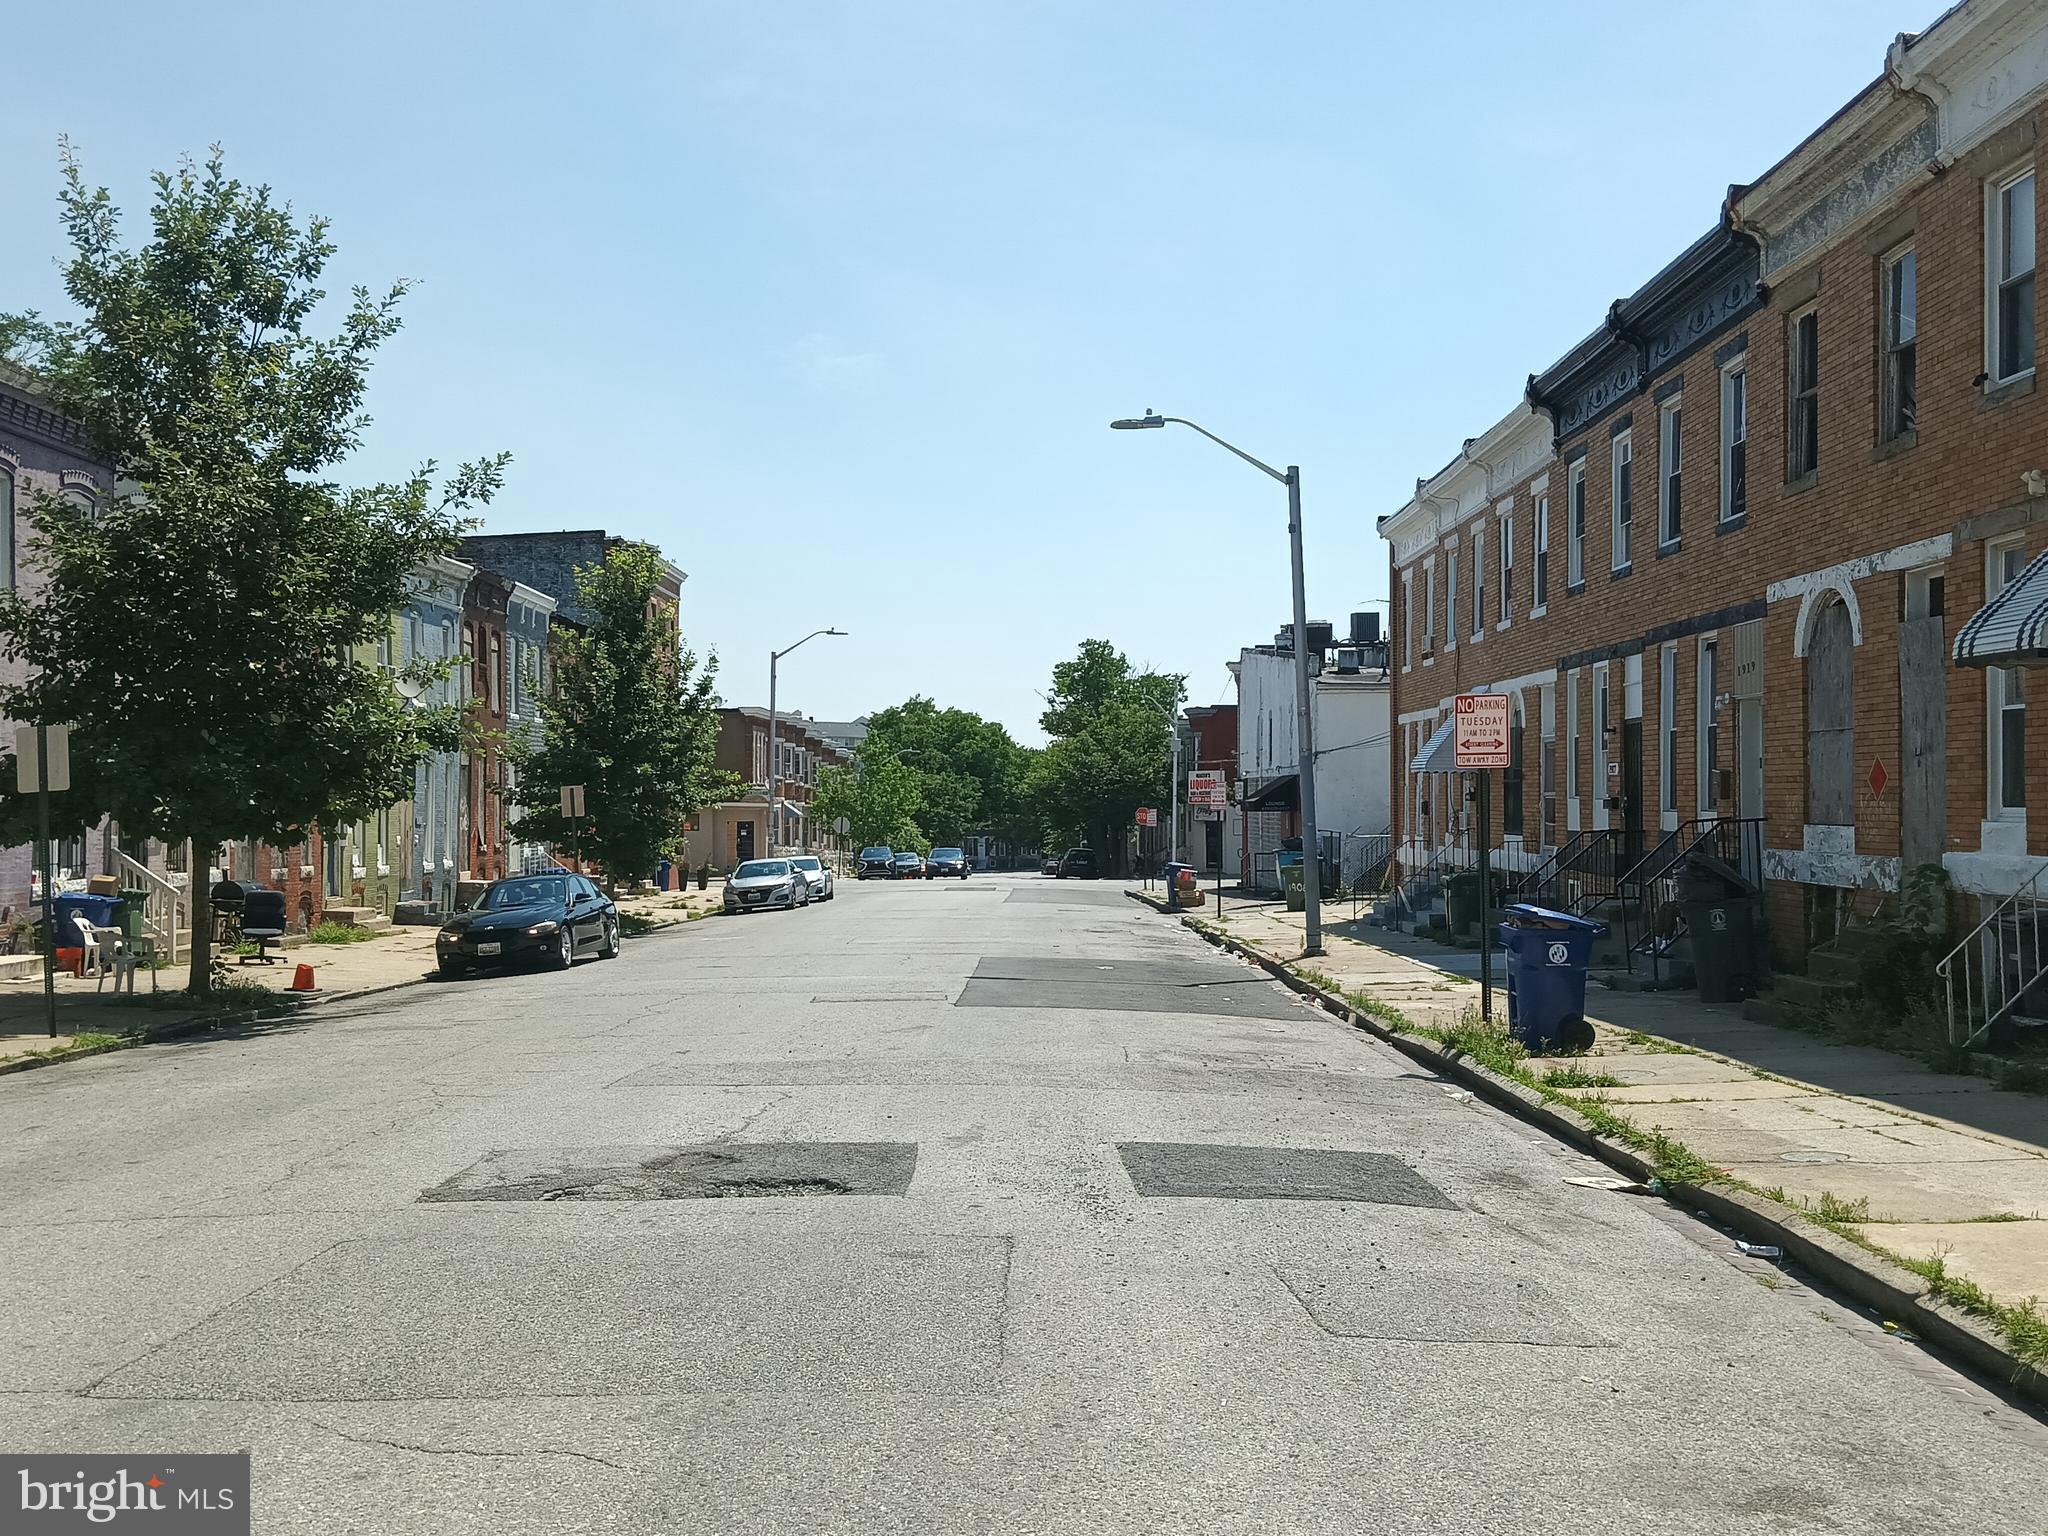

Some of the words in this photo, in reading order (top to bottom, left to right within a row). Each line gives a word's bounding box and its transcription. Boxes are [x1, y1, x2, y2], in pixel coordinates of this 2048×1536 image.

[1737, 661, 1756, 677] 1919
[1457, 698, 1474, 713] NO
[1475, 699, 1506, 710] PARKING
[1460, 716, 1504, 726] TUESDAY
[1479, 729, 1487, 737] TO
[1458, 756, 1472, 764] TOW
[1472, 756, 1490, 764] AWAY
[1491, 755, 1506, 764] ZONE
[1136, 812, 1147, 820] STO
